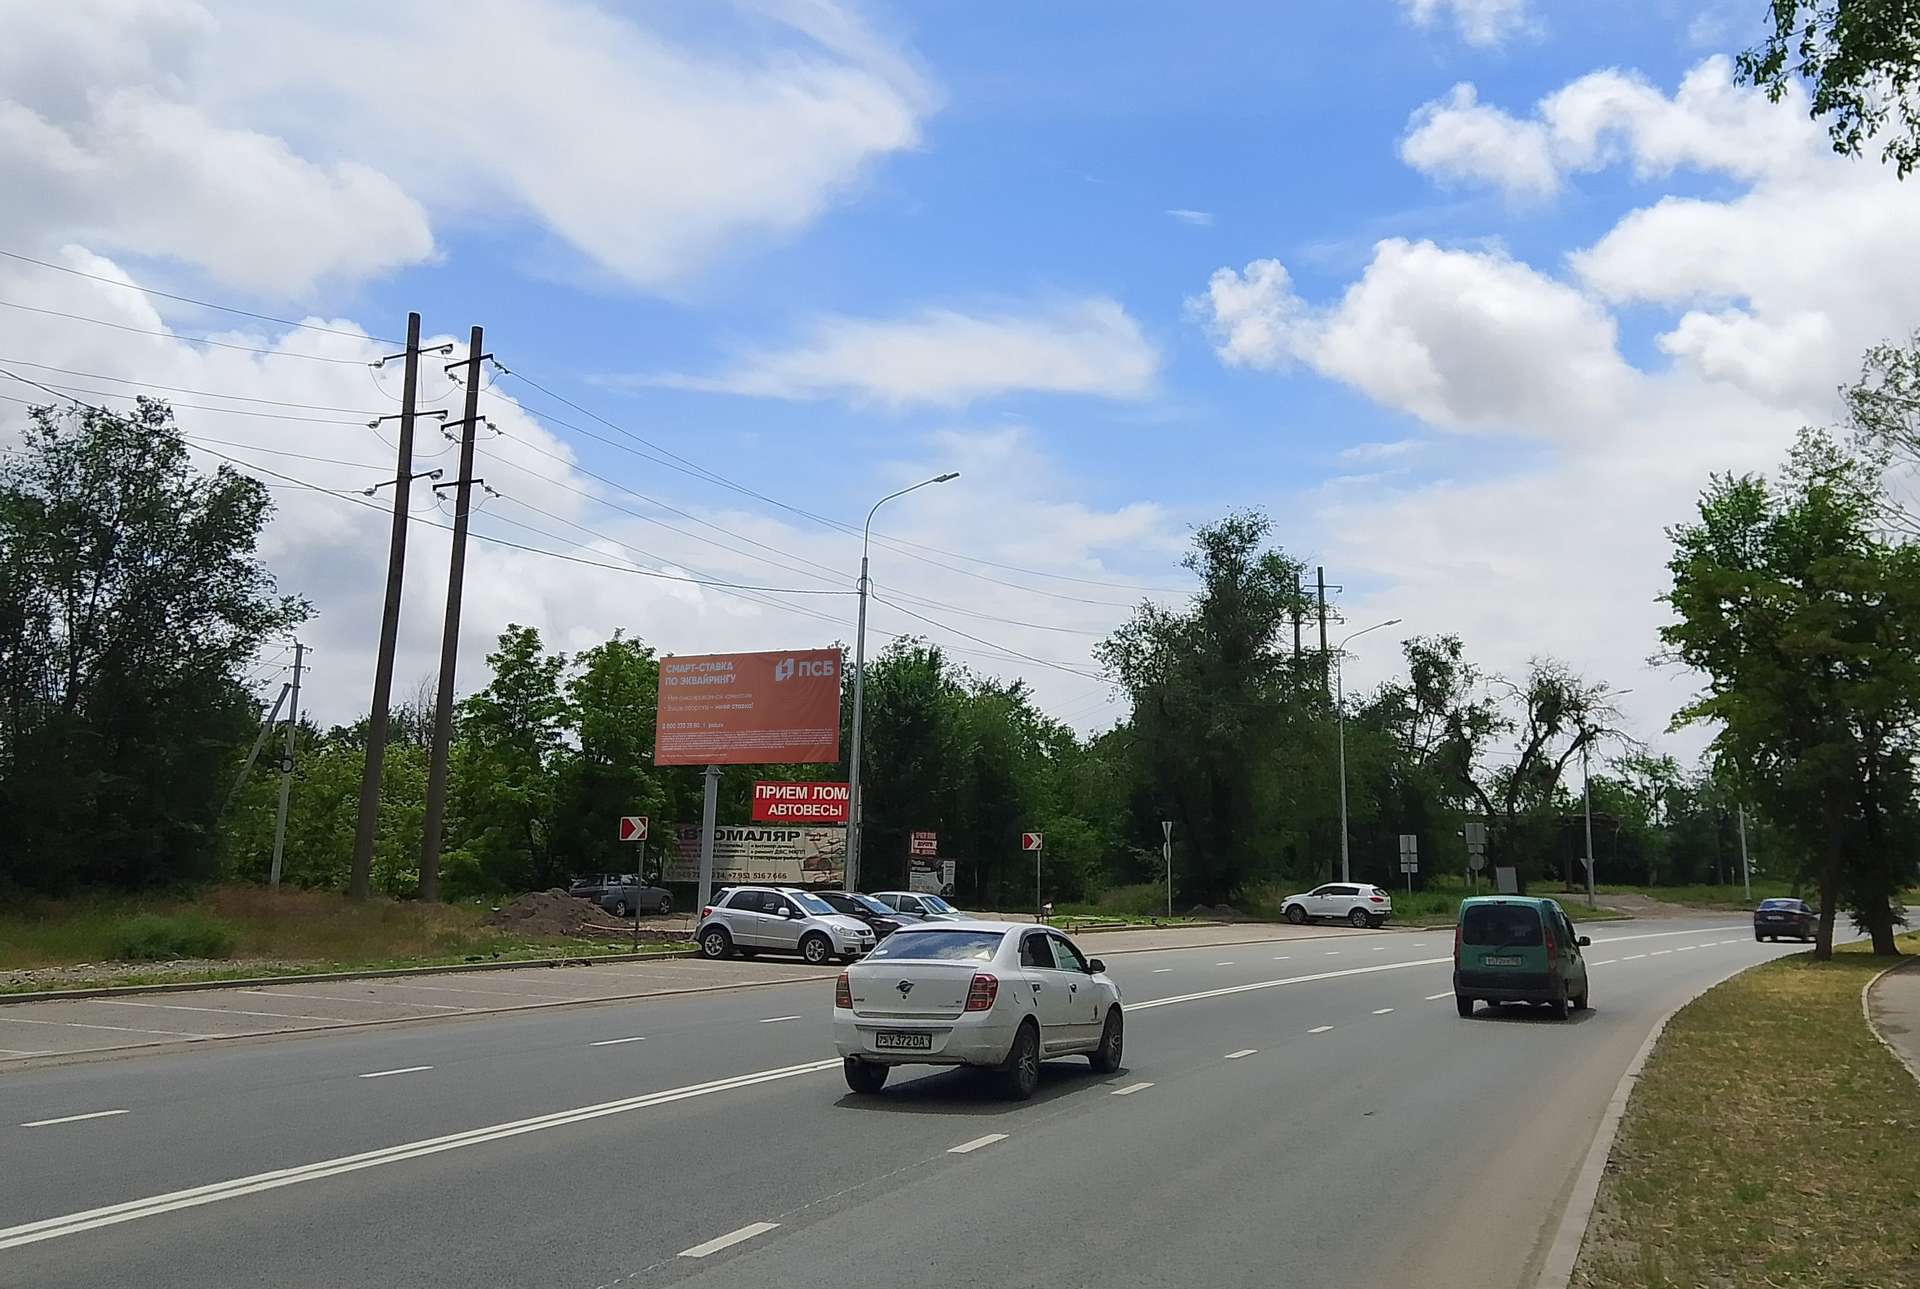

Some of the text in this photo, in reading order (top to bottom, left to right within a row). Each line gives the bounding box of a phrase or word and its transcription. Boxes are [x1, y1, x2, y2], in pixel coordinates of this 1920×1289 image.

[665, 662, 733, 673] СМАРТ-СТАВКА
[798, 660, 834, 677] ПСБ
[665, 674, 736, 686] ПО ЭКВАЙРИНГУ
[755, 785, 808, 800] ПРИЕМ
[768, 803, 842, 817] АВТОВЕСЫ
